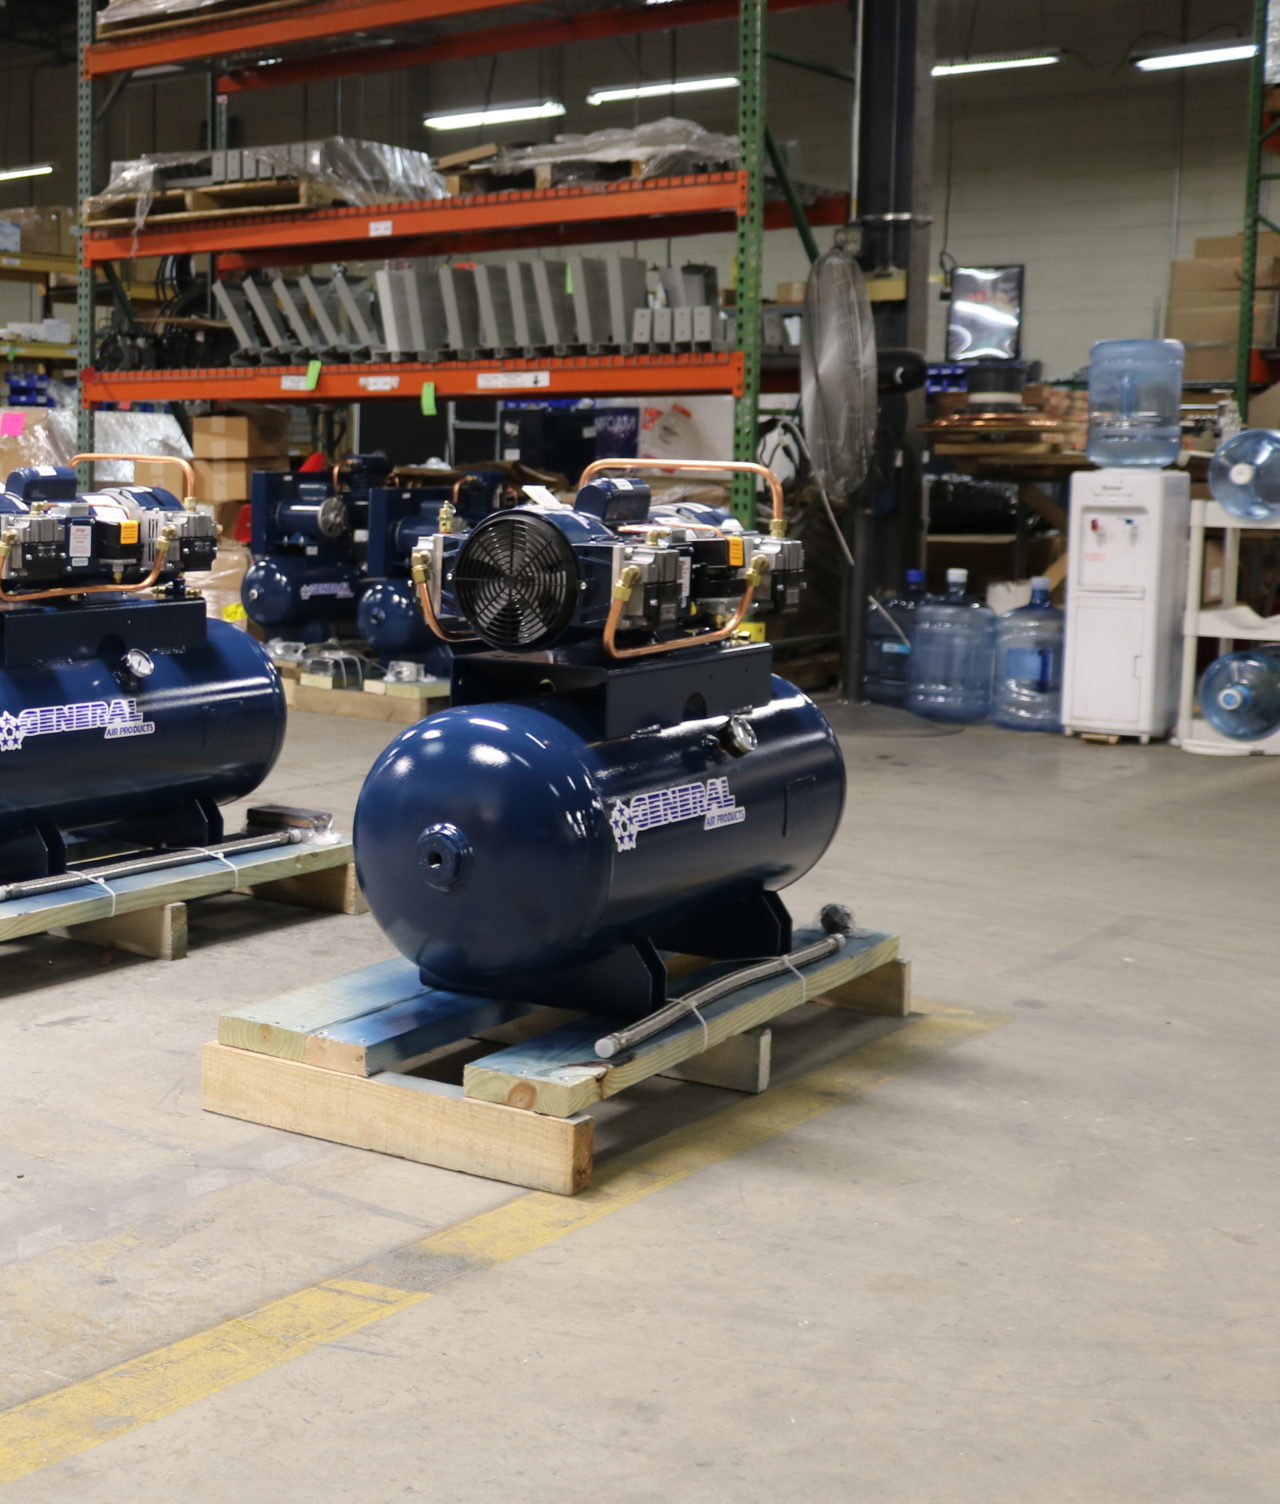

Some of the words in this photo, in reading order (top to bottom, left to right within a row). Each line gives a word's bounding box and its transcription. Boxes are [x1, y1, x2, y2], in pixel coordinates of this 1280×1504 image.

[21, 700, 143, 734] GENERAL
[106, 727, 119, 737] AIR
[119, 723, 154, 736] PRODUCTS
[631, 776, 735, 829] GENERAL
[705, 816, 716, 828] AIR
[716, 809, 745, 825] PRODUCTS
